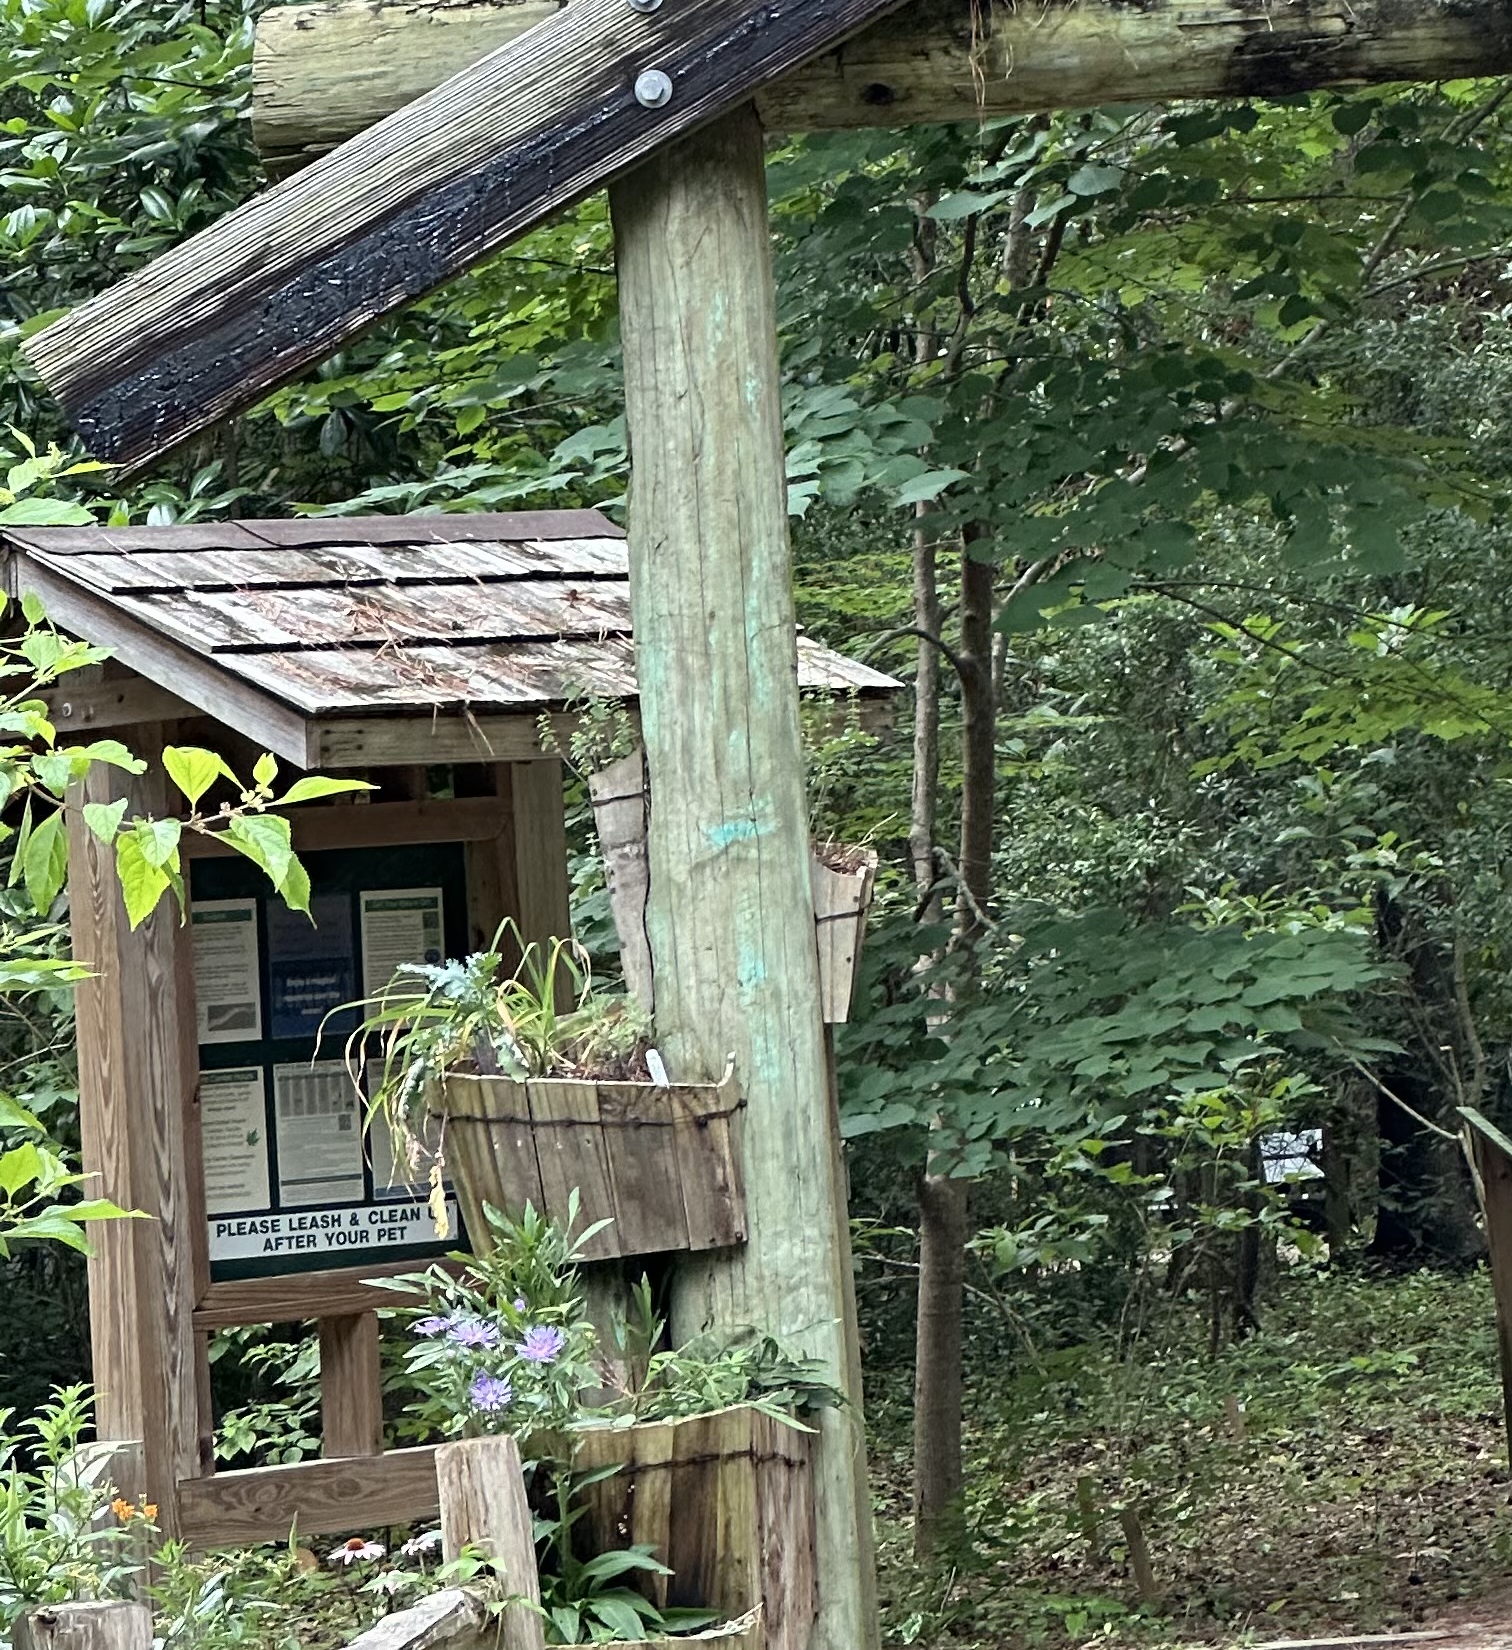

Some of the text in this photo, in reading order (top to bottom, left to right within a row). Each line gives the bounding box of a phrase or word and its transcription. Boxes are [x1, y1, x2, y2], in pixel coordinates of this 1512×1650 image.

[216, 1204, 450, 1238] PLEASE LEASH & CLEAN U
[263, 1225, 407, 1252] AFTER YOUR PET
